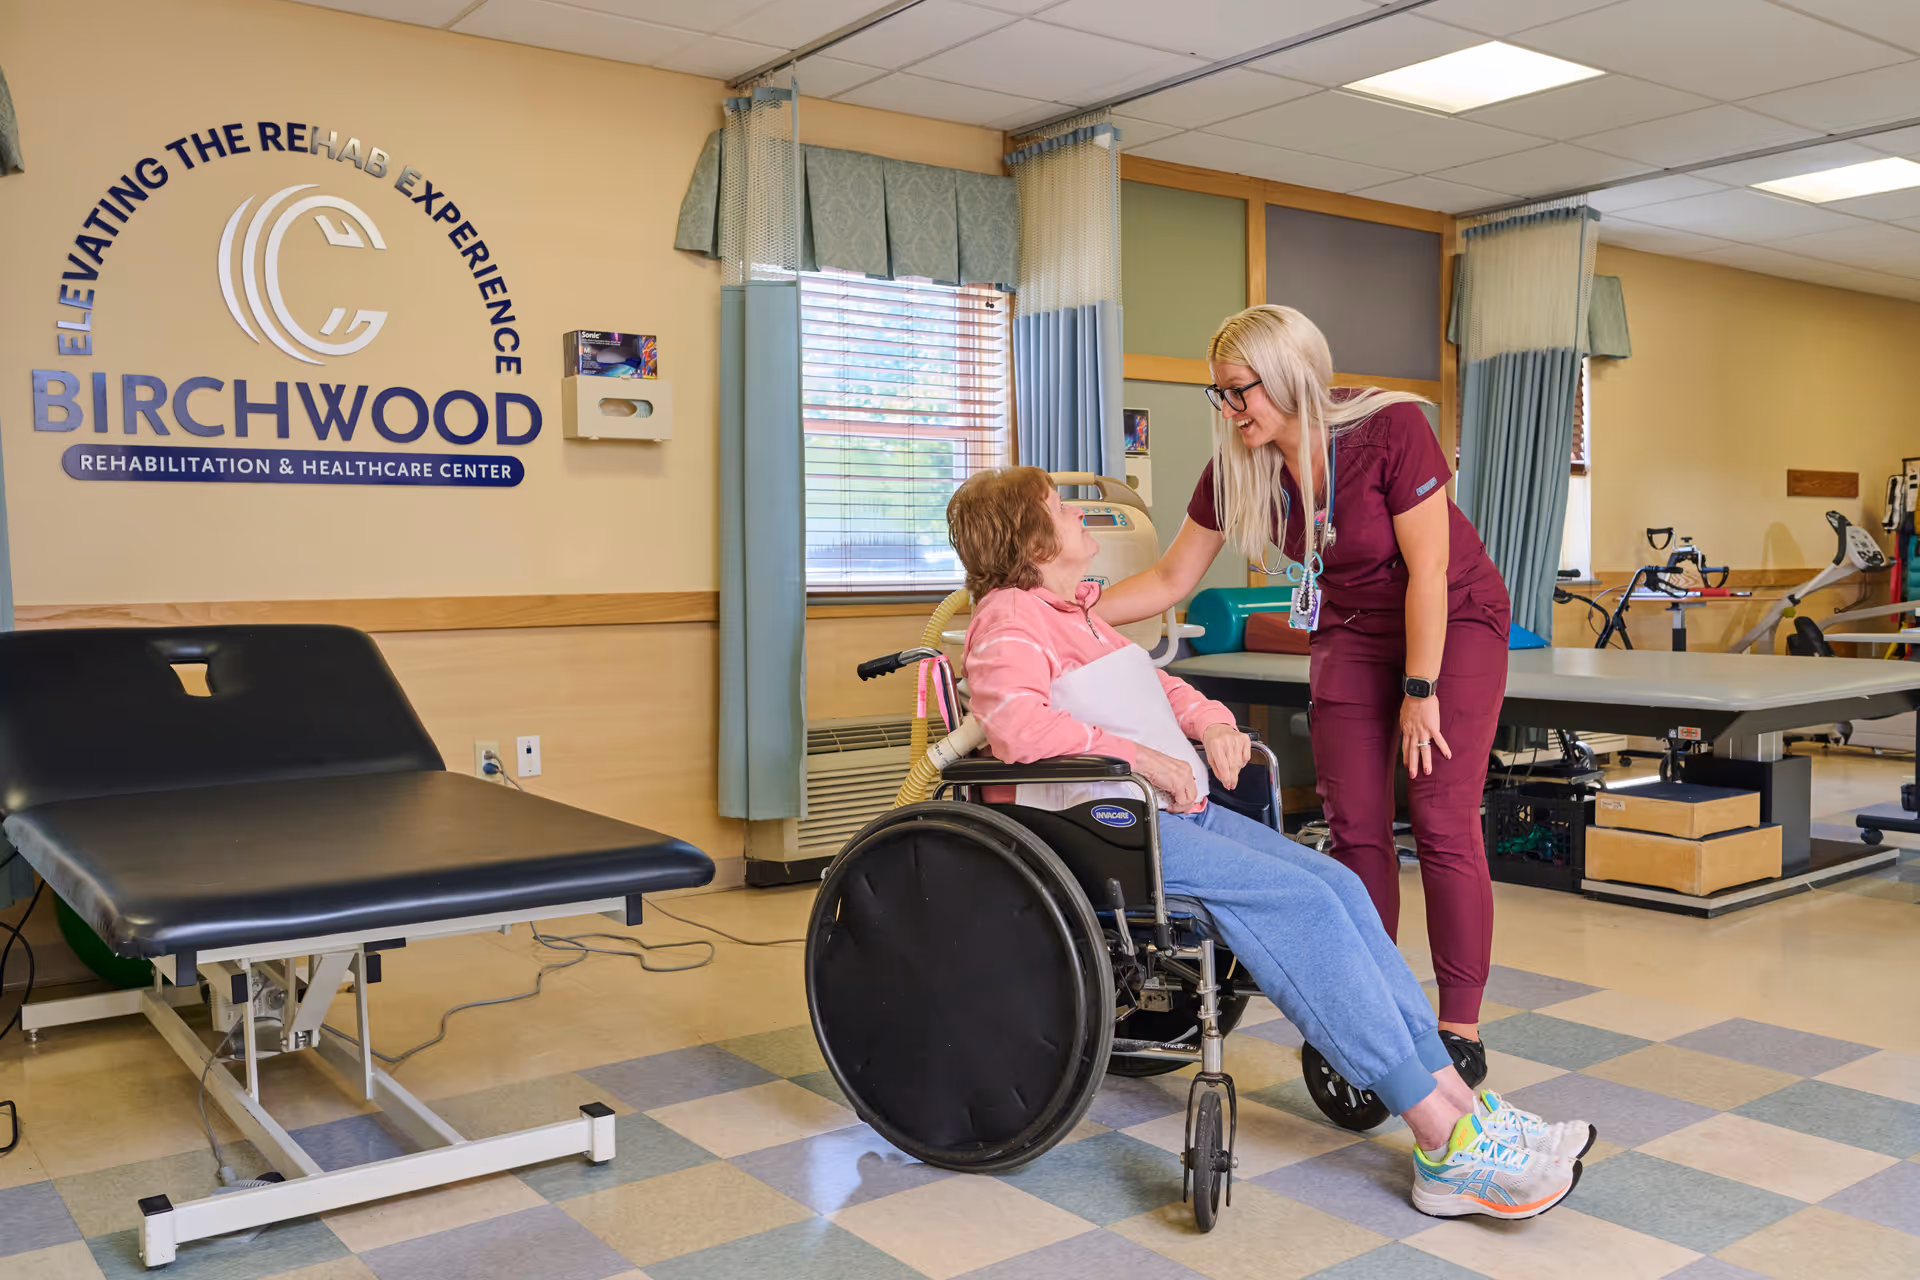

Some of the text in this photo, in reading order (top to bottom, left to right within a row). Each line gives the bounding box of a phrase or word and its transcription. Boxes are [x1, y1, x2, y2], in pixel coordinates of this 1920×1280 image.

[56, 121, 522, 375] ELEVATING THE REHAB EXPERIENCE
[581, 331, 600, 339] Sonic
[32, 369, 543, 446] BIRCHWOOD
[80, 454, 512, 479] REHABILITATION & HEALTHCARE CENTER
[1096, 811, 1129, 819] INVACARE
